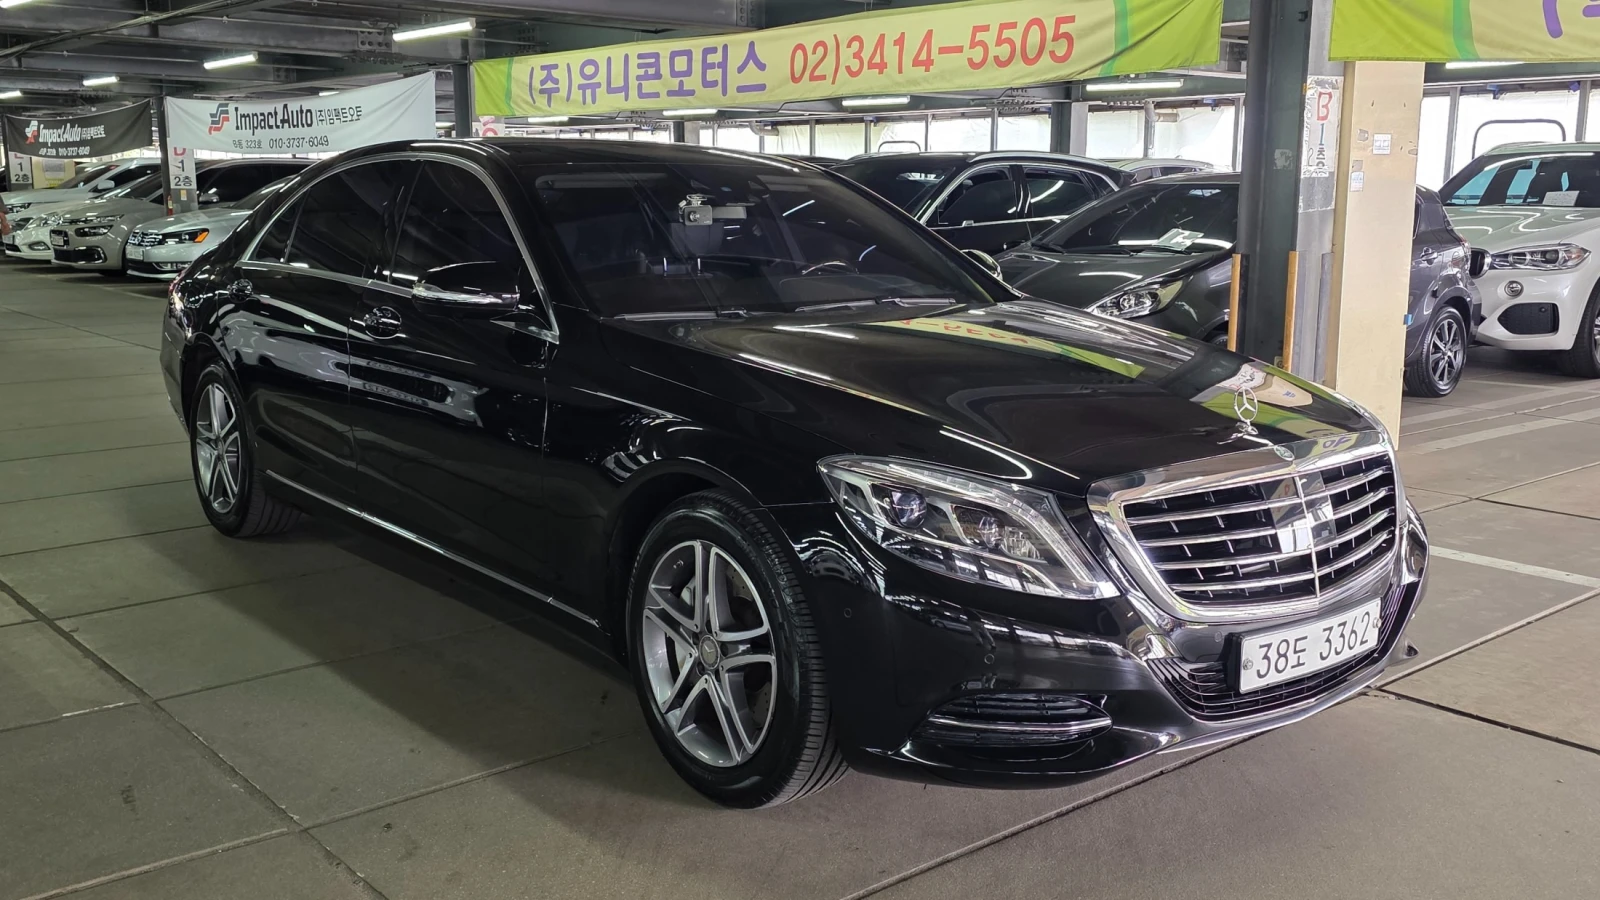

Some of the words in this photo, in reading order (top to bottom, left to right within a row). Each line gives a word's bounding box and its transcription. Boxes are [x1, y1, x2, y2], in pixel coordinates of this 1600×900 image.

[528, 40, 767, 108] (주)유니콘모터스
[789, 14, 1077, 85] 02)3414-5505
[245, 139, 263, 149] 323호
[17, 161, 23, 172] 1
[174, 175, 193, 187] 2층
[1319, 610, 1371, 660] 3362
